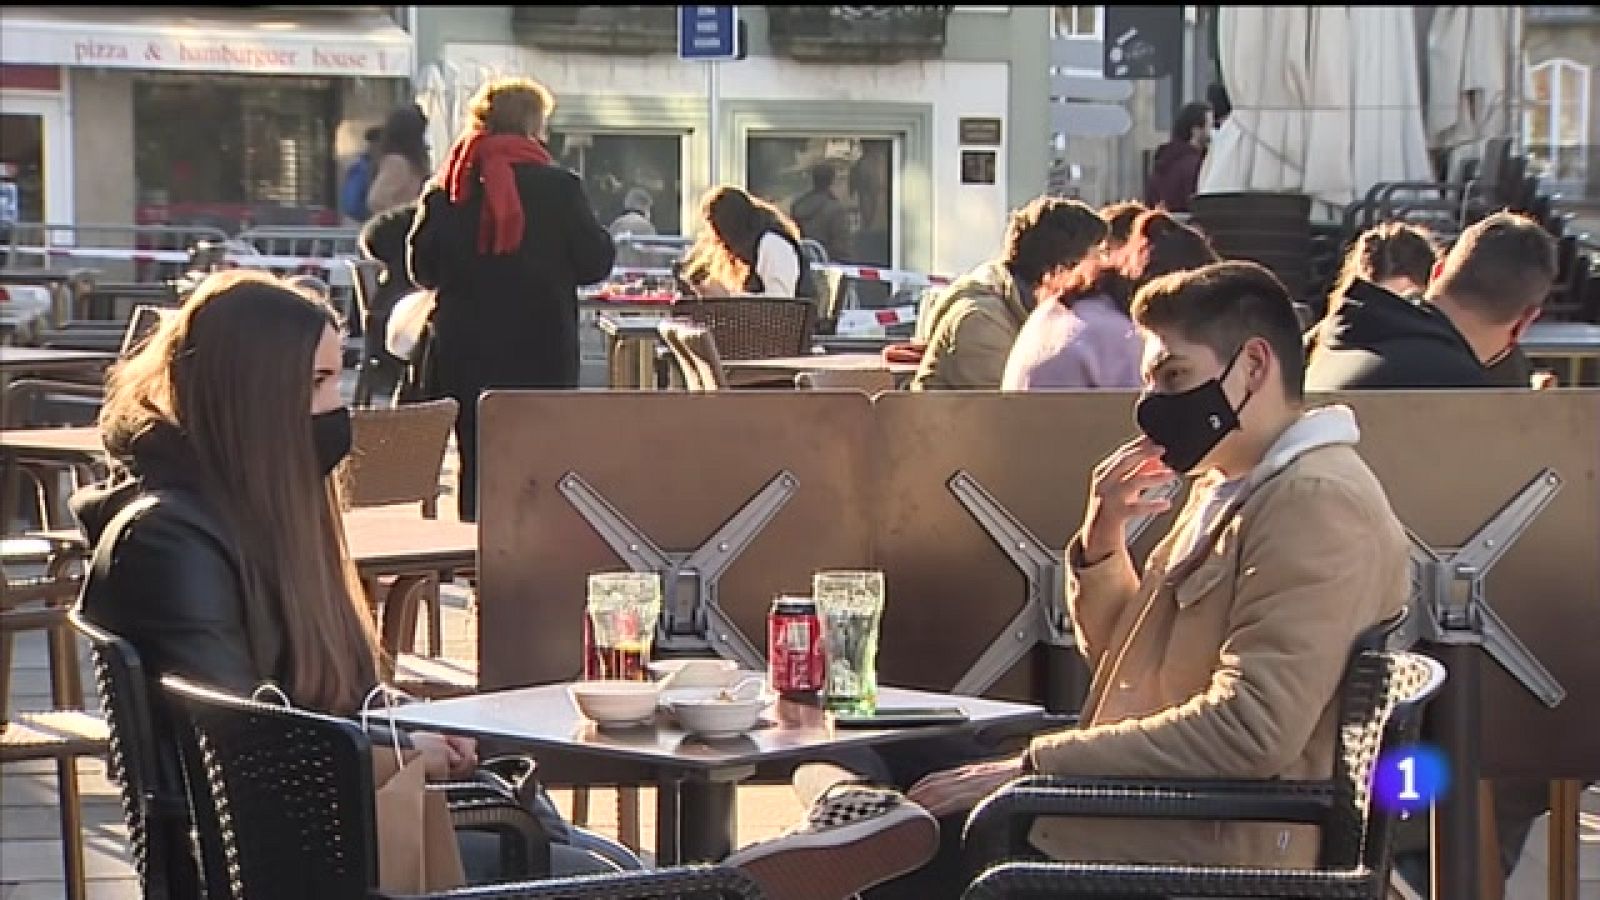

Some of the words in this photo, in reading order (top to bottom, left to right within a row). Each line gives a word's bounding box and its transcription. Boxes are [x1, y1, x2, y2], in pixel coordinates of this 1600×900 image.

[75, 40, 128, 63] pizza
[144, 41, 161, 60] &
[312, 47, 367, 67] house
